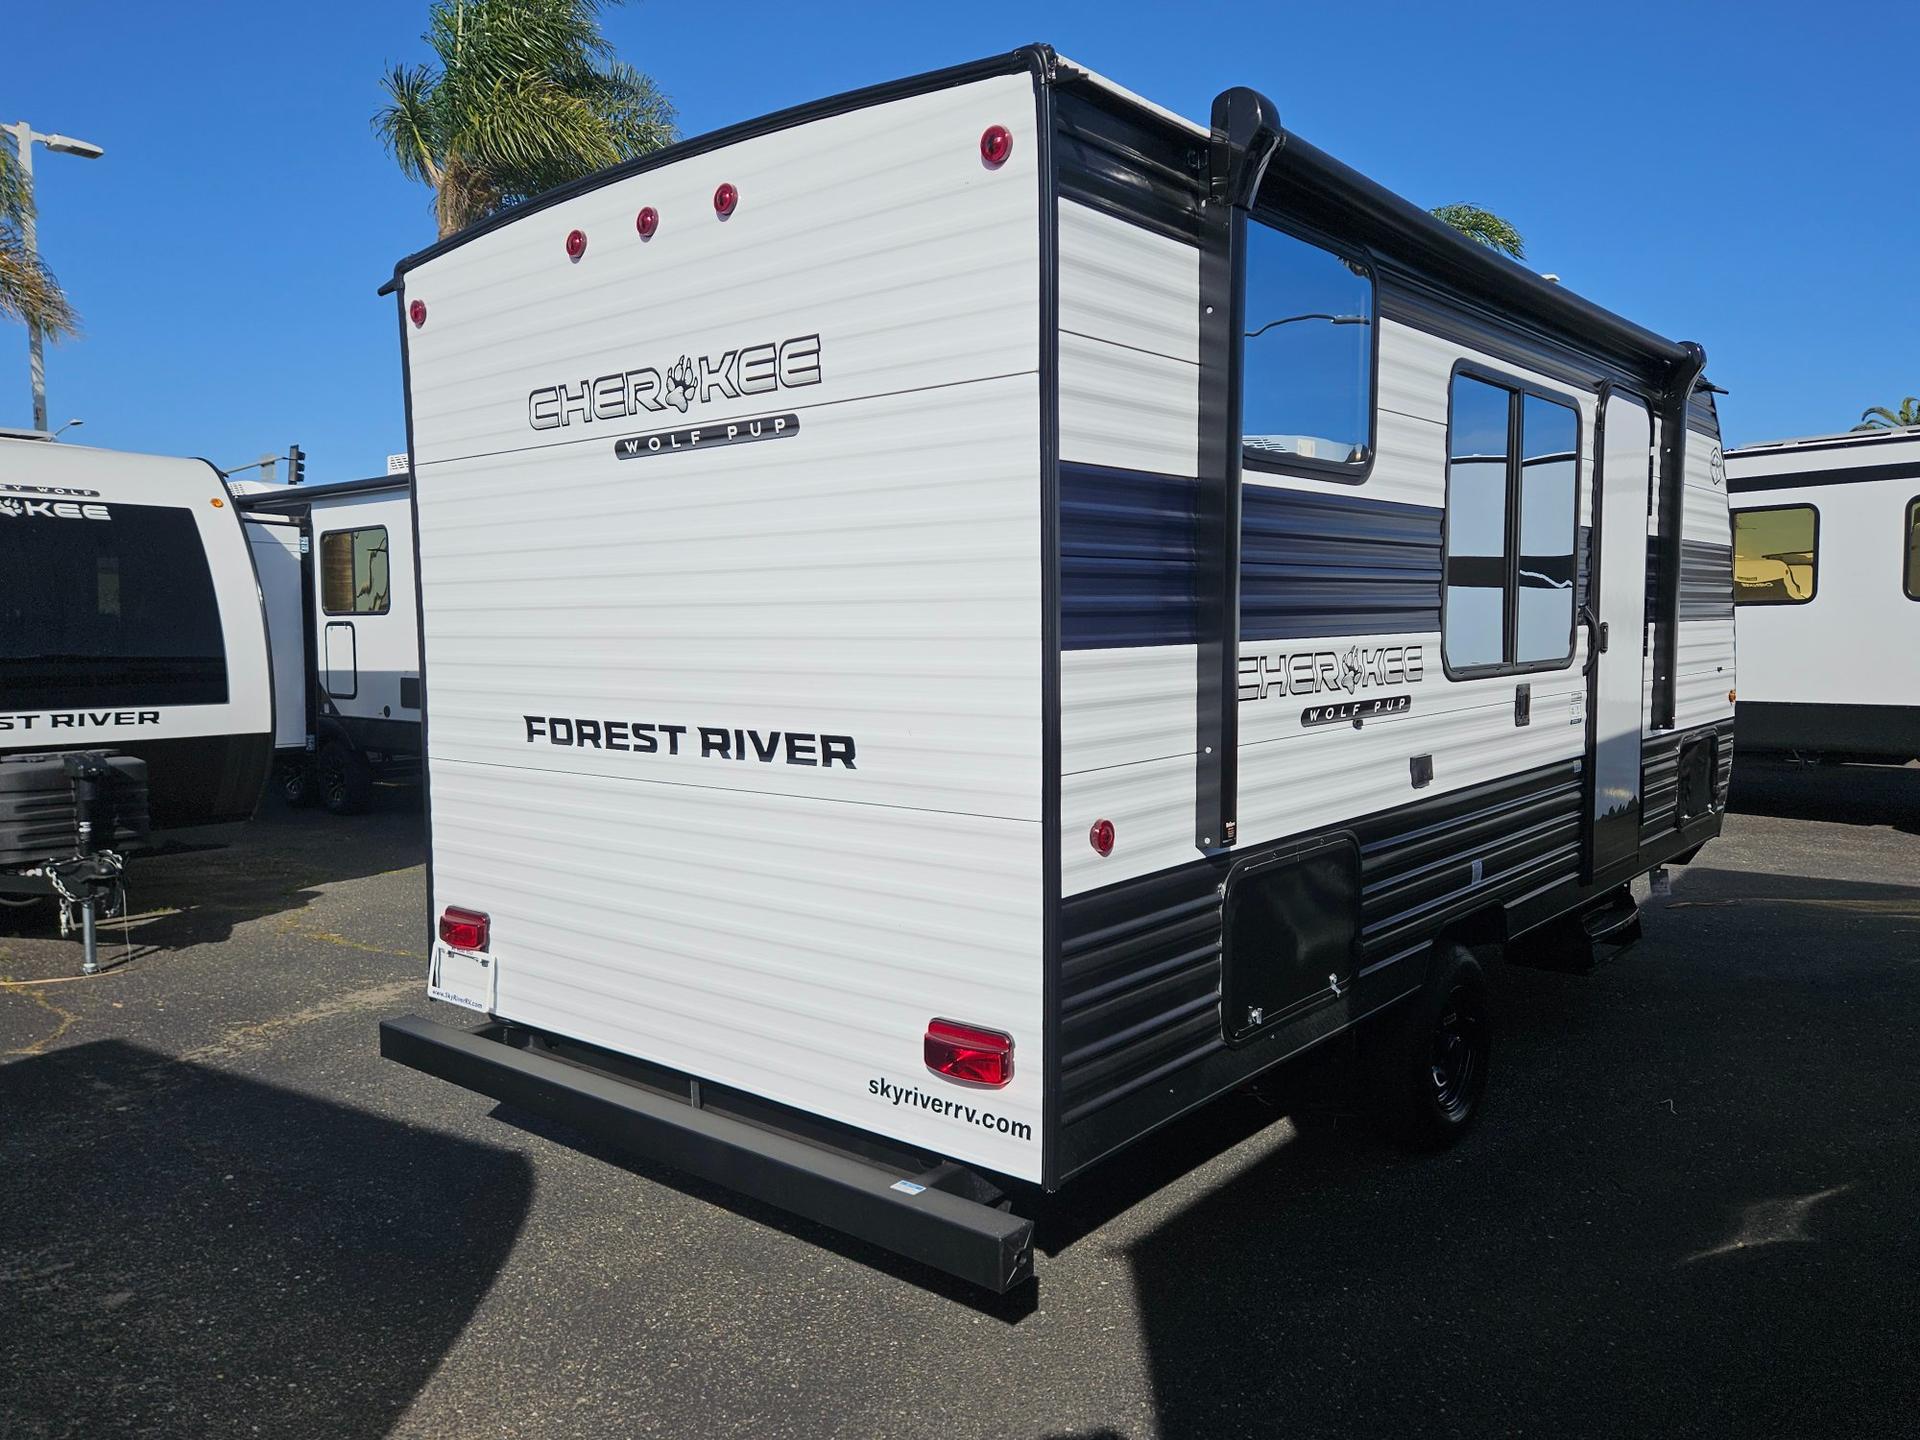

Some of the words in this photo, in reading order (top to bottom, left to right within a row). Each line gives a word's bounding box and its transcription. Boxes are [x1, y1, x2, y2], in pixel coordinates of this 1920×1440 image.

[625, 431, 701, 454] WOLF
[727, 418, 786, 441] PUP
[37, 487, 91, 496] WOLF
[50, 711, 160, 728] RIVER
[1309, 704, 1361, 722] WOLF
[1374, 698, 1406, 713] PUP
[523, 715, 687, 755] FOREST
[697, 726, 857, 769] RIVER
[868, 1077, 1032, 1141] skyriverrv.com
